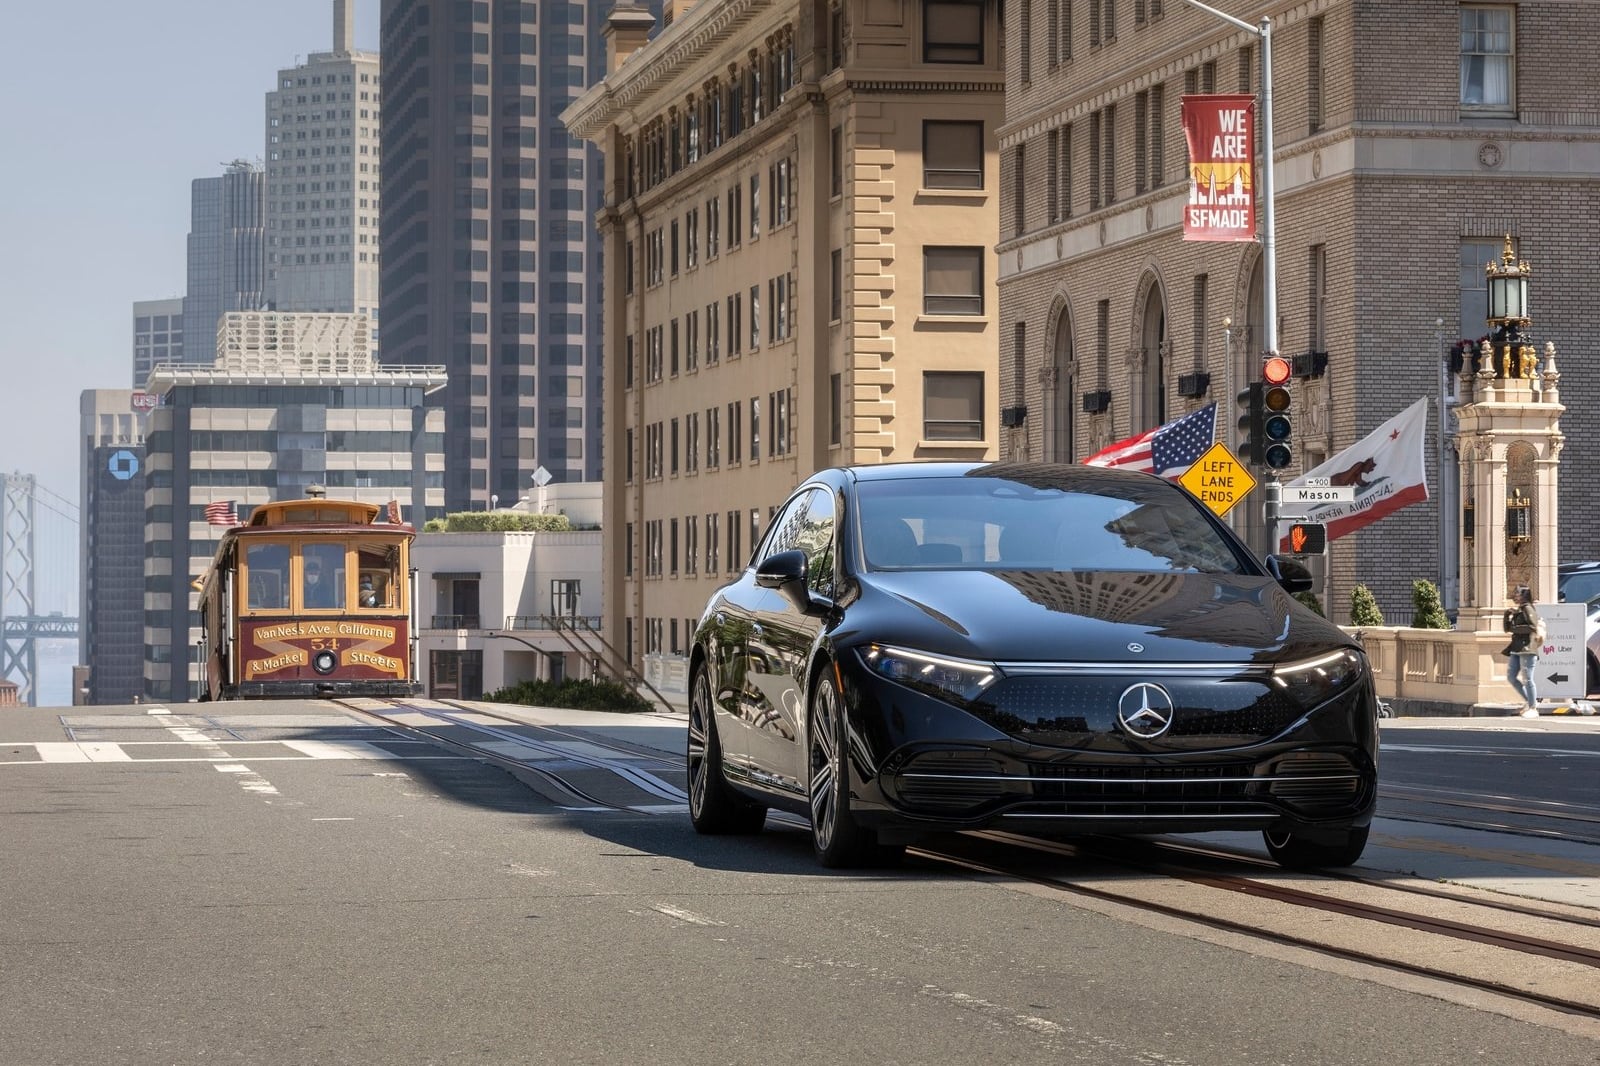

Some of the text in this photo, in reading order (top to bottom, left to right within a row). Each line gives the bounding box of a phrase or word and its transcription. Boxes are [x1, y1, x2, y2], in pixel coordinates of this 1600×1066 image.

[1218, 109, 1247, 133] WE
[1211, 135, 1247, 159] ARE
[1190, 209, 1249, 229] SFMADE
[1203, 461, 1234, 473] LEFT
[1201, 475, 1234, 488] LANE
[1314, 478, 1329, 486] 900
[1201, 490, 1234, 503] ENDS
[1298, 490, 1339, 500] Mason
[256, 628, 276, 639] Van
[277, 625, 305, 637] Ness
[339, 623, 394, 639] California
[311, 638, 340, 650] 54
[252, 652, 303, 671] & Market
[350, 651, 397, 669] Streets
